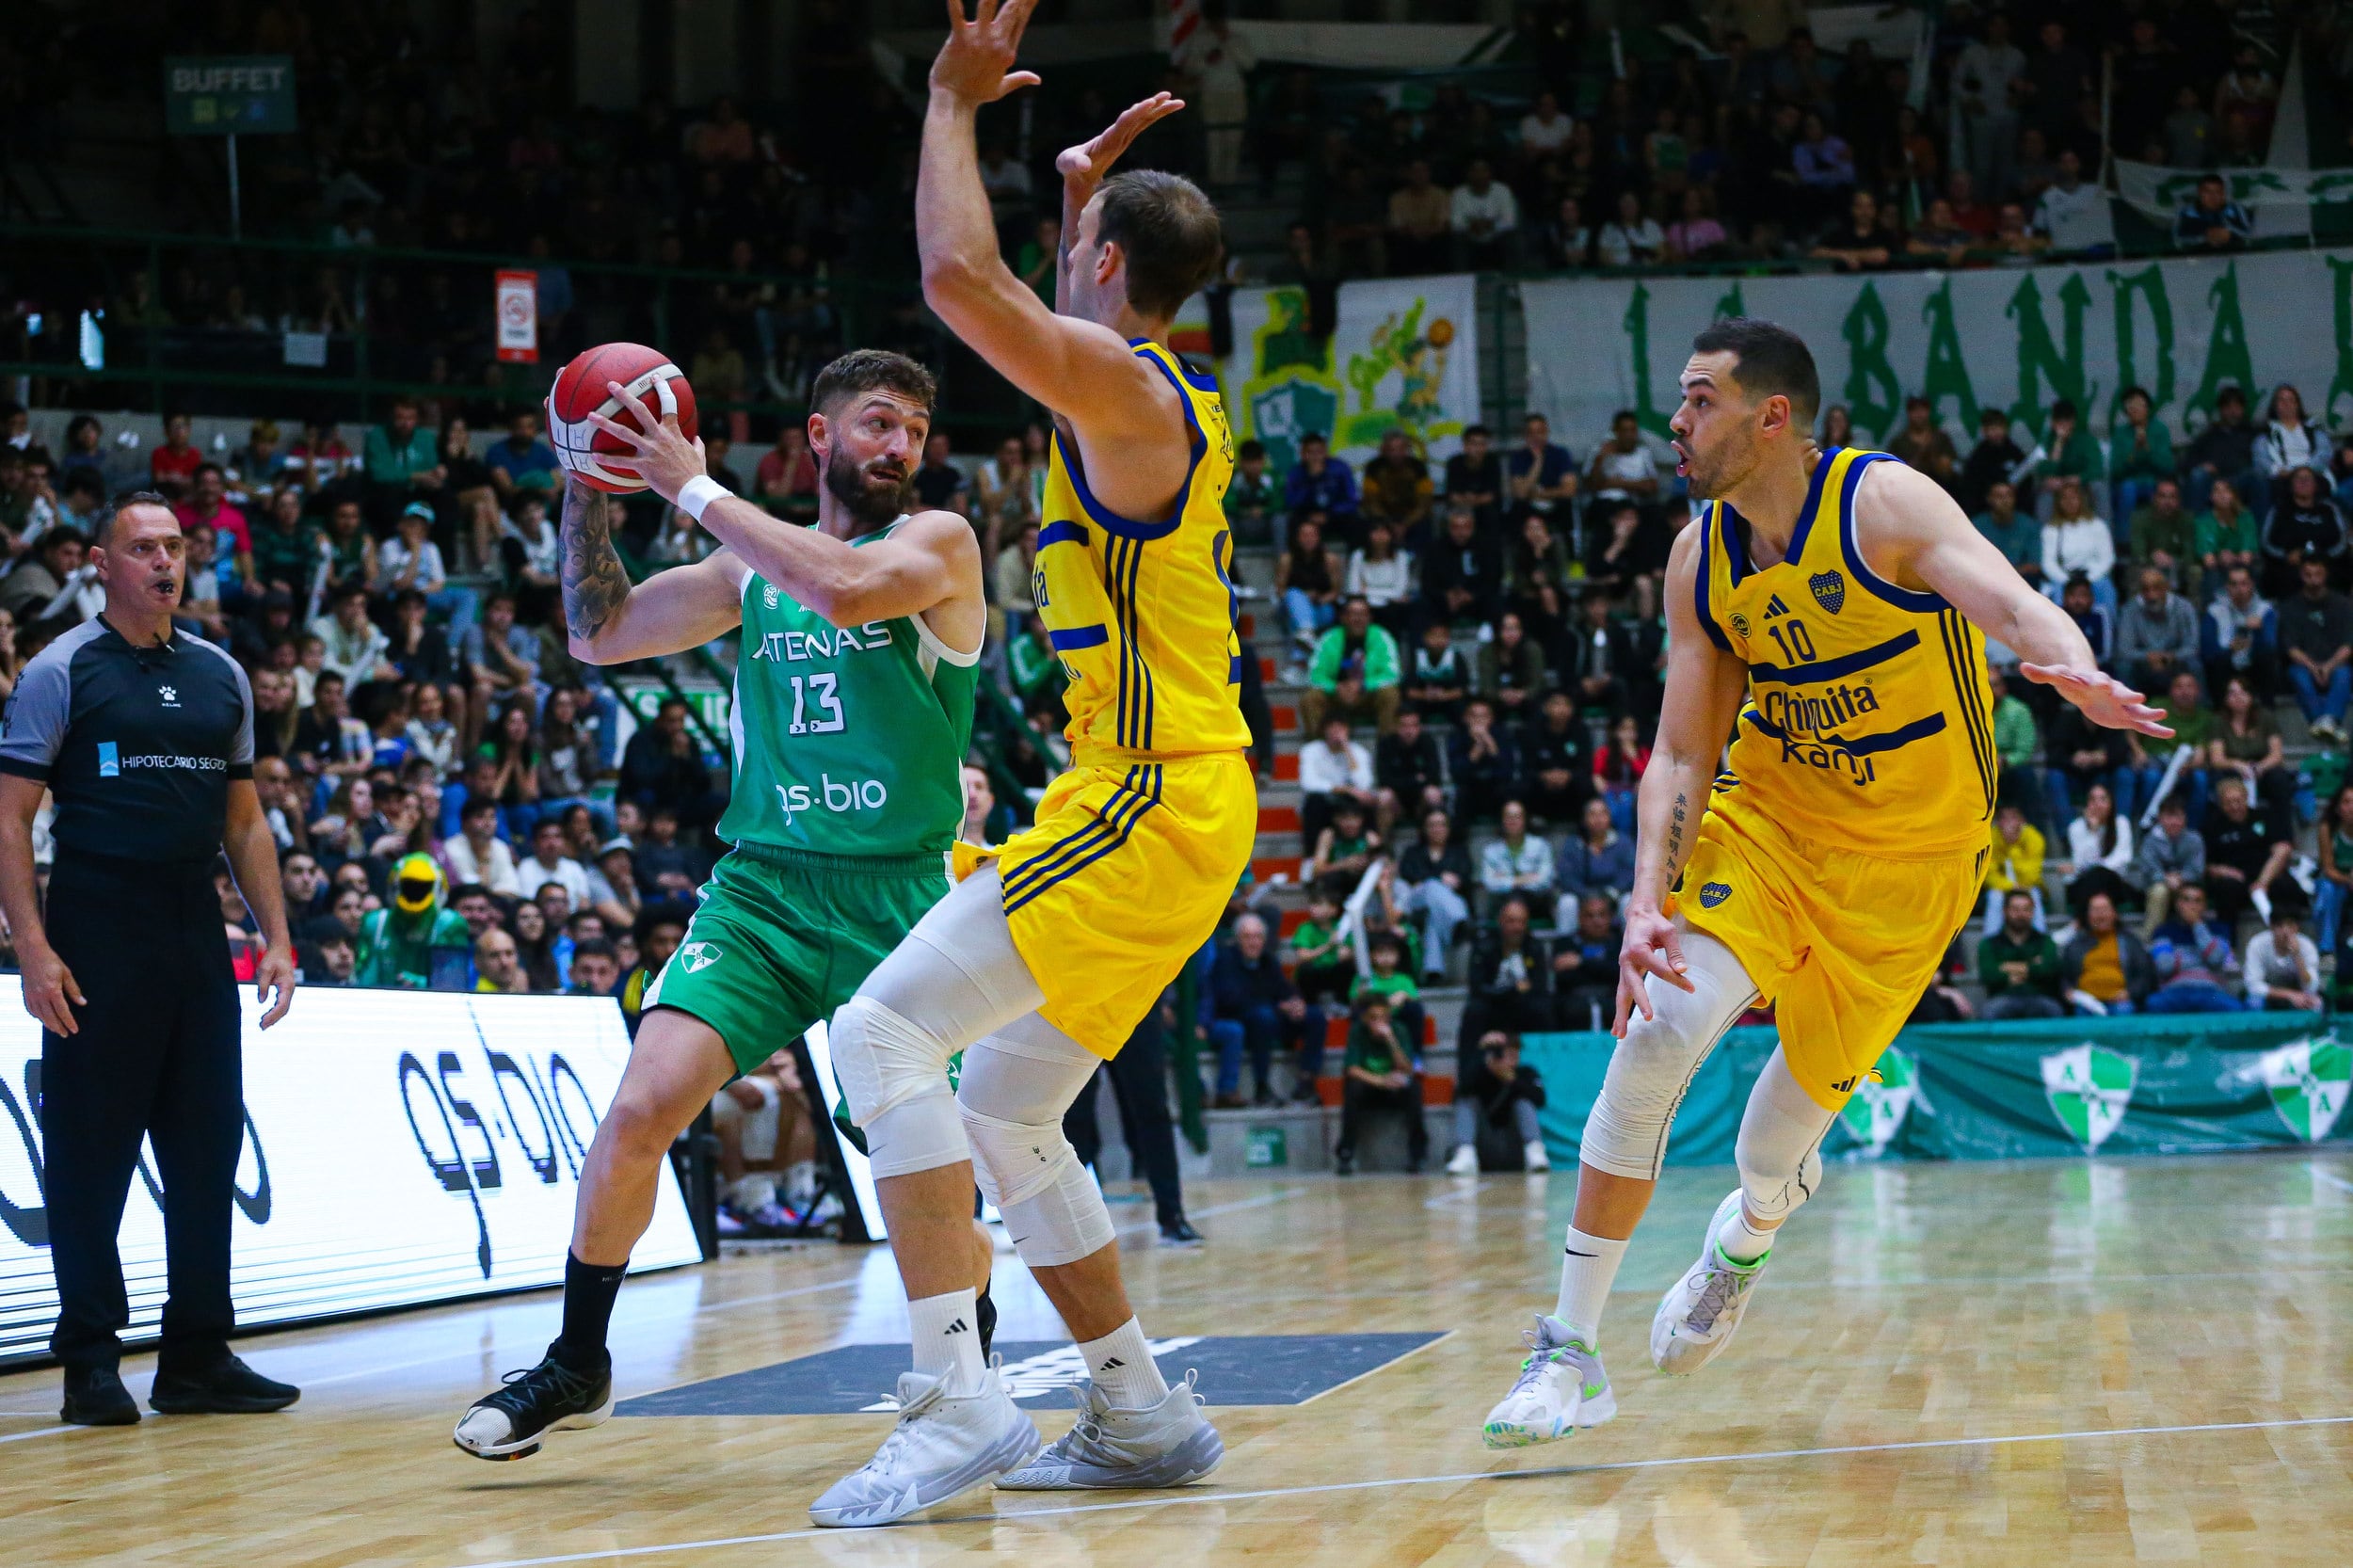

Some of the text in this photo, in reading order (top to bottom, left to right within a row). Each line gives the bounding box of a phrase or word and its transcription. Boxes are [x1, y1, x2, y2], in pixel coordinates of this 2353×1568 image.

[172, 66, 285, 92] BUFFET
[1842, 258, 2265, 446] BANDA
[1815, 583, 1842, 598] CABJ
[752, 619, 893, 663] ATENAS
[1769, 619, 1817, 665] 10
[789, 672, 844, 735] 13
[1765, 683, 1881, 743] Chiquita
[122, 755, 197, 770] HIPOTECARIO
[1782, 738, 1876, 787] Kanji
